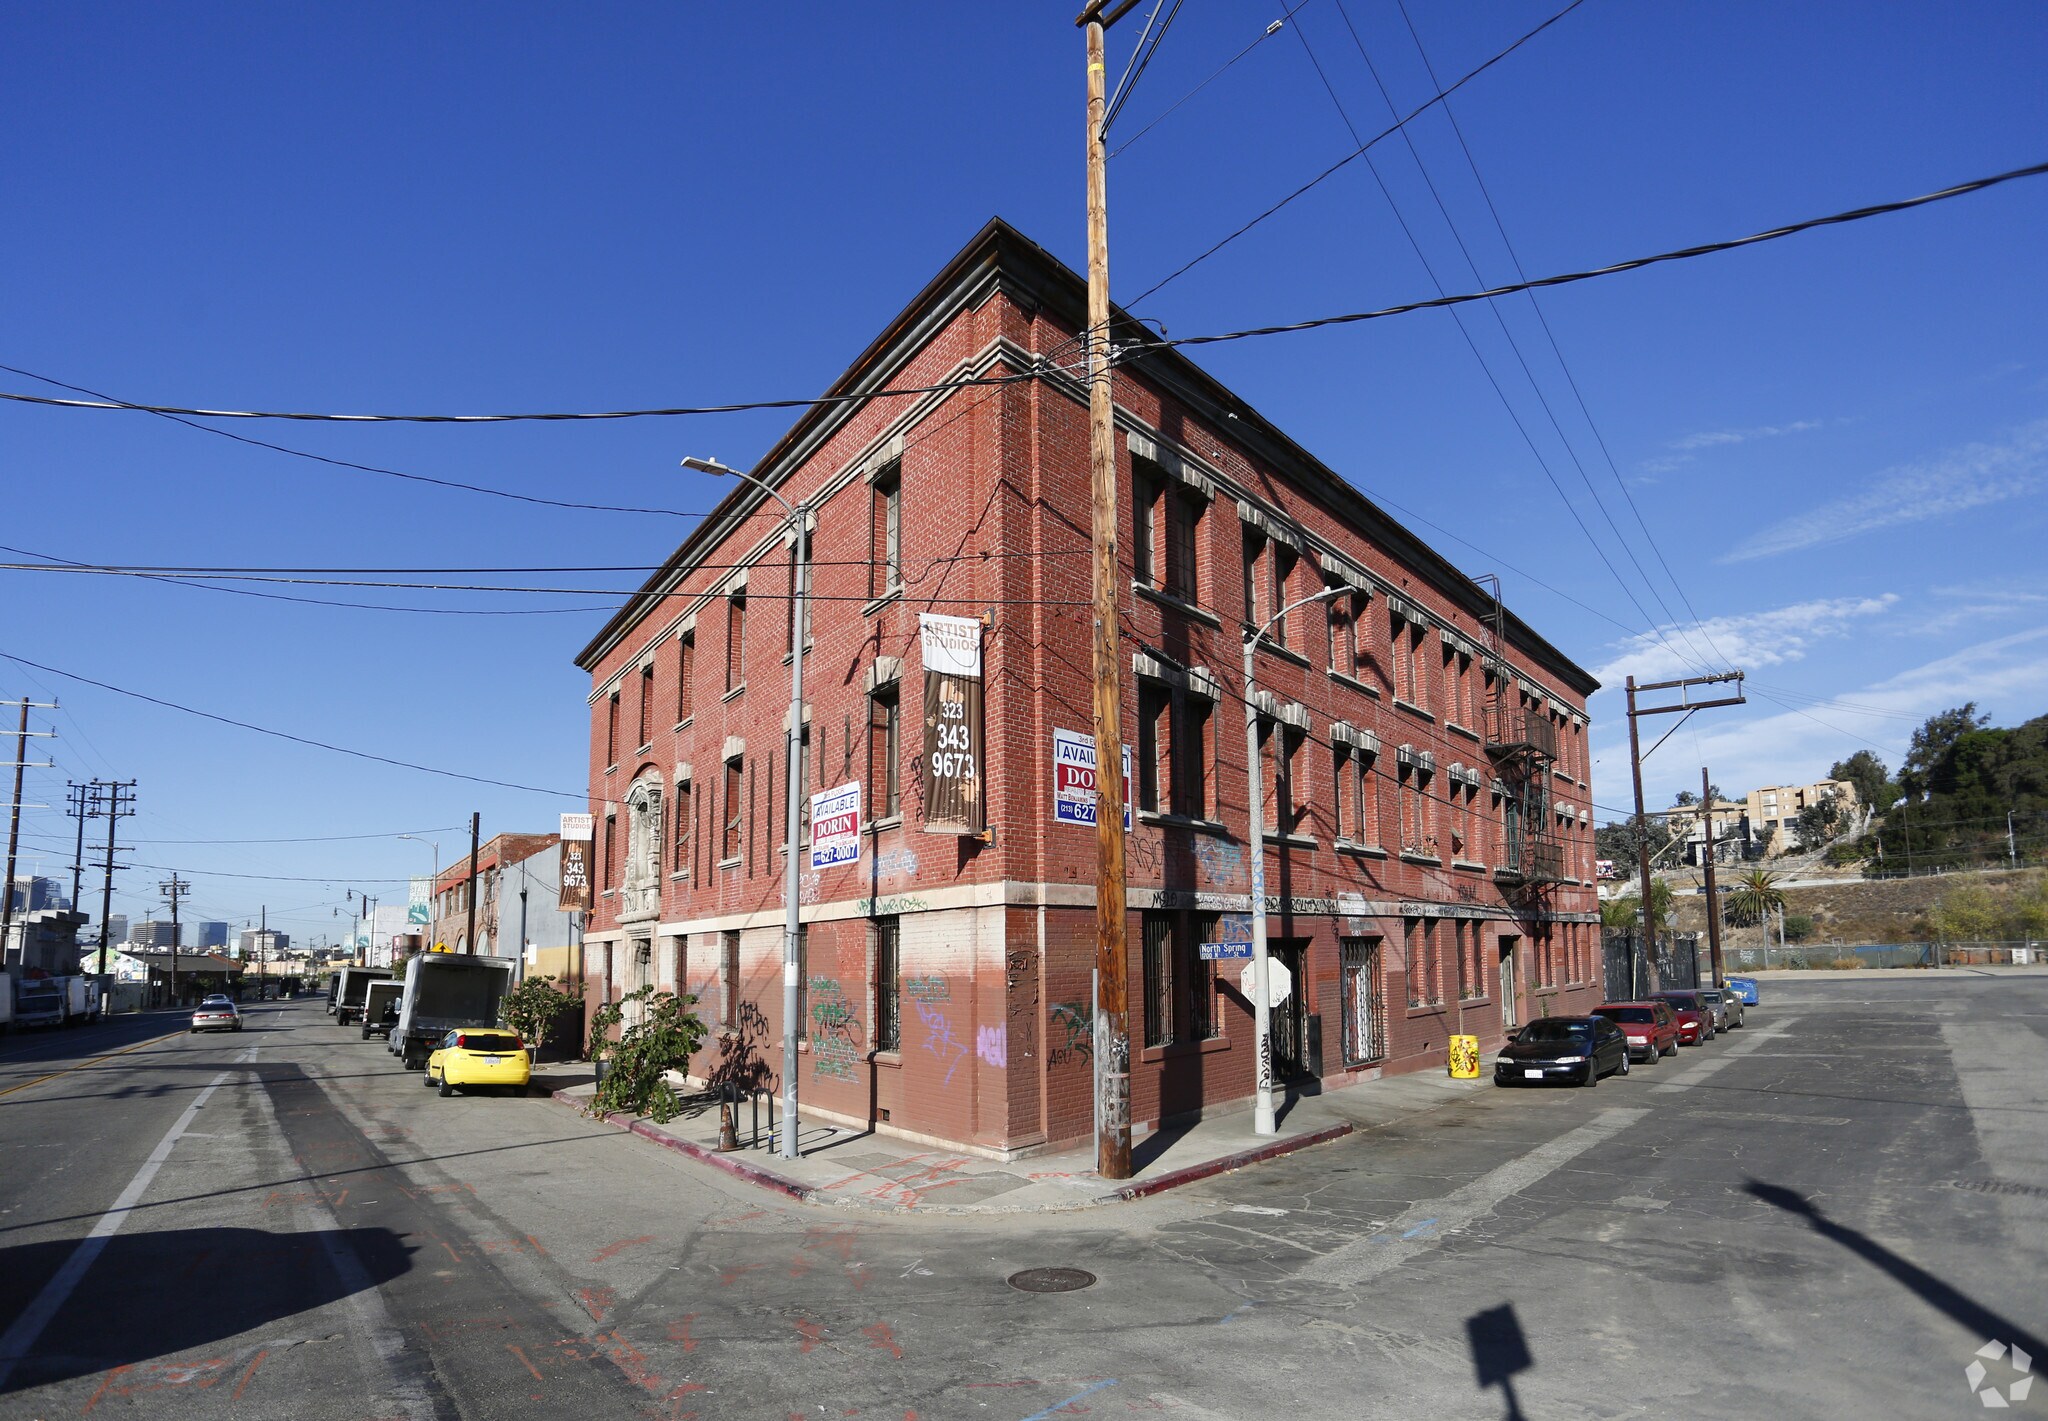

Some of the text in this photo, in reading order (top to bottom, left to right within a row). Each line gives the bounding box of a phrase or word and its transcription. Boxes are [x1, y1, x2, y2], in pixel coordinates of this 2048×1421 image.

[925, 620, 976, 640] ARTIST
[925, 635, 977, 651] STUDIOS
[942, 702, 964, 719] 323
[937, 723, 970, 750] 343
[1062, 745, 1096, 765] AVAIL
[931, 752, 975, 779] 9673
[816, 796, 855, 818] AVAILABLE
[1060, 804, 1074, 814] (213)
[562, 816, 591, 824] ARTIST
[816, 815, 852, 838] DORIN
[569, 852, 582, 861] 323
[821, 844, 856, 863] 627-0007
[566, 861, 585, 875] 343
[563, 874, 587, 887] 9673
[1201, 943, 1246, 954] North Spring
